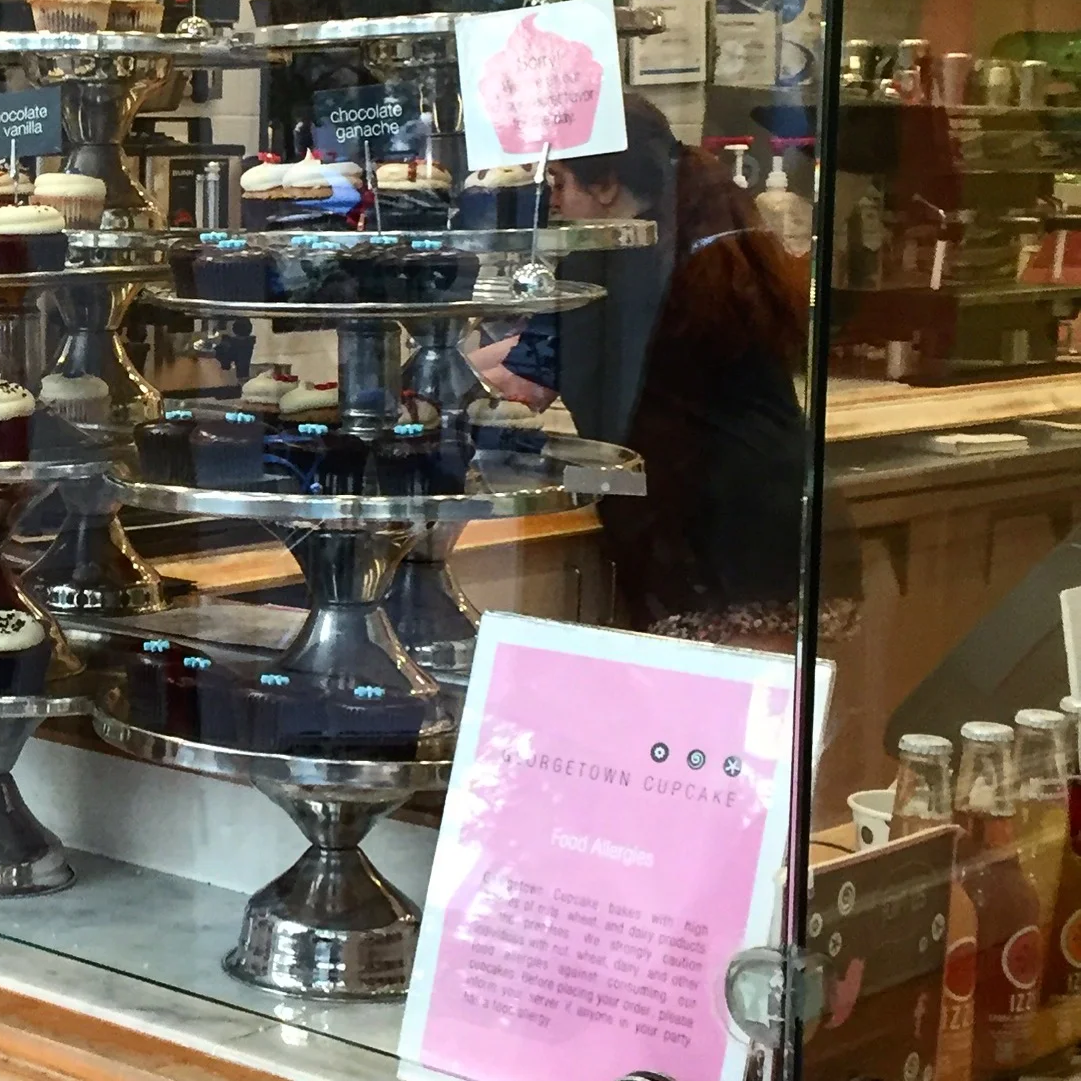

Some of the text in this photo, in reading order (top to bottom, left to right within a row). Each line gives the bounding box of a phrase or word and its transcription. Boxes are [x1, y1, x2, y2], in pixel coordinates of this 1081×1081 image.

[330, 104, 402, 123] chocolate
[3, 120, 43, 137] vanilla
[336, 121, 400, 143] ganache
[502, 747, 738, 809] GORGETOWN CUPCAKE
[551, 828, 654, 868] Food Allergies
